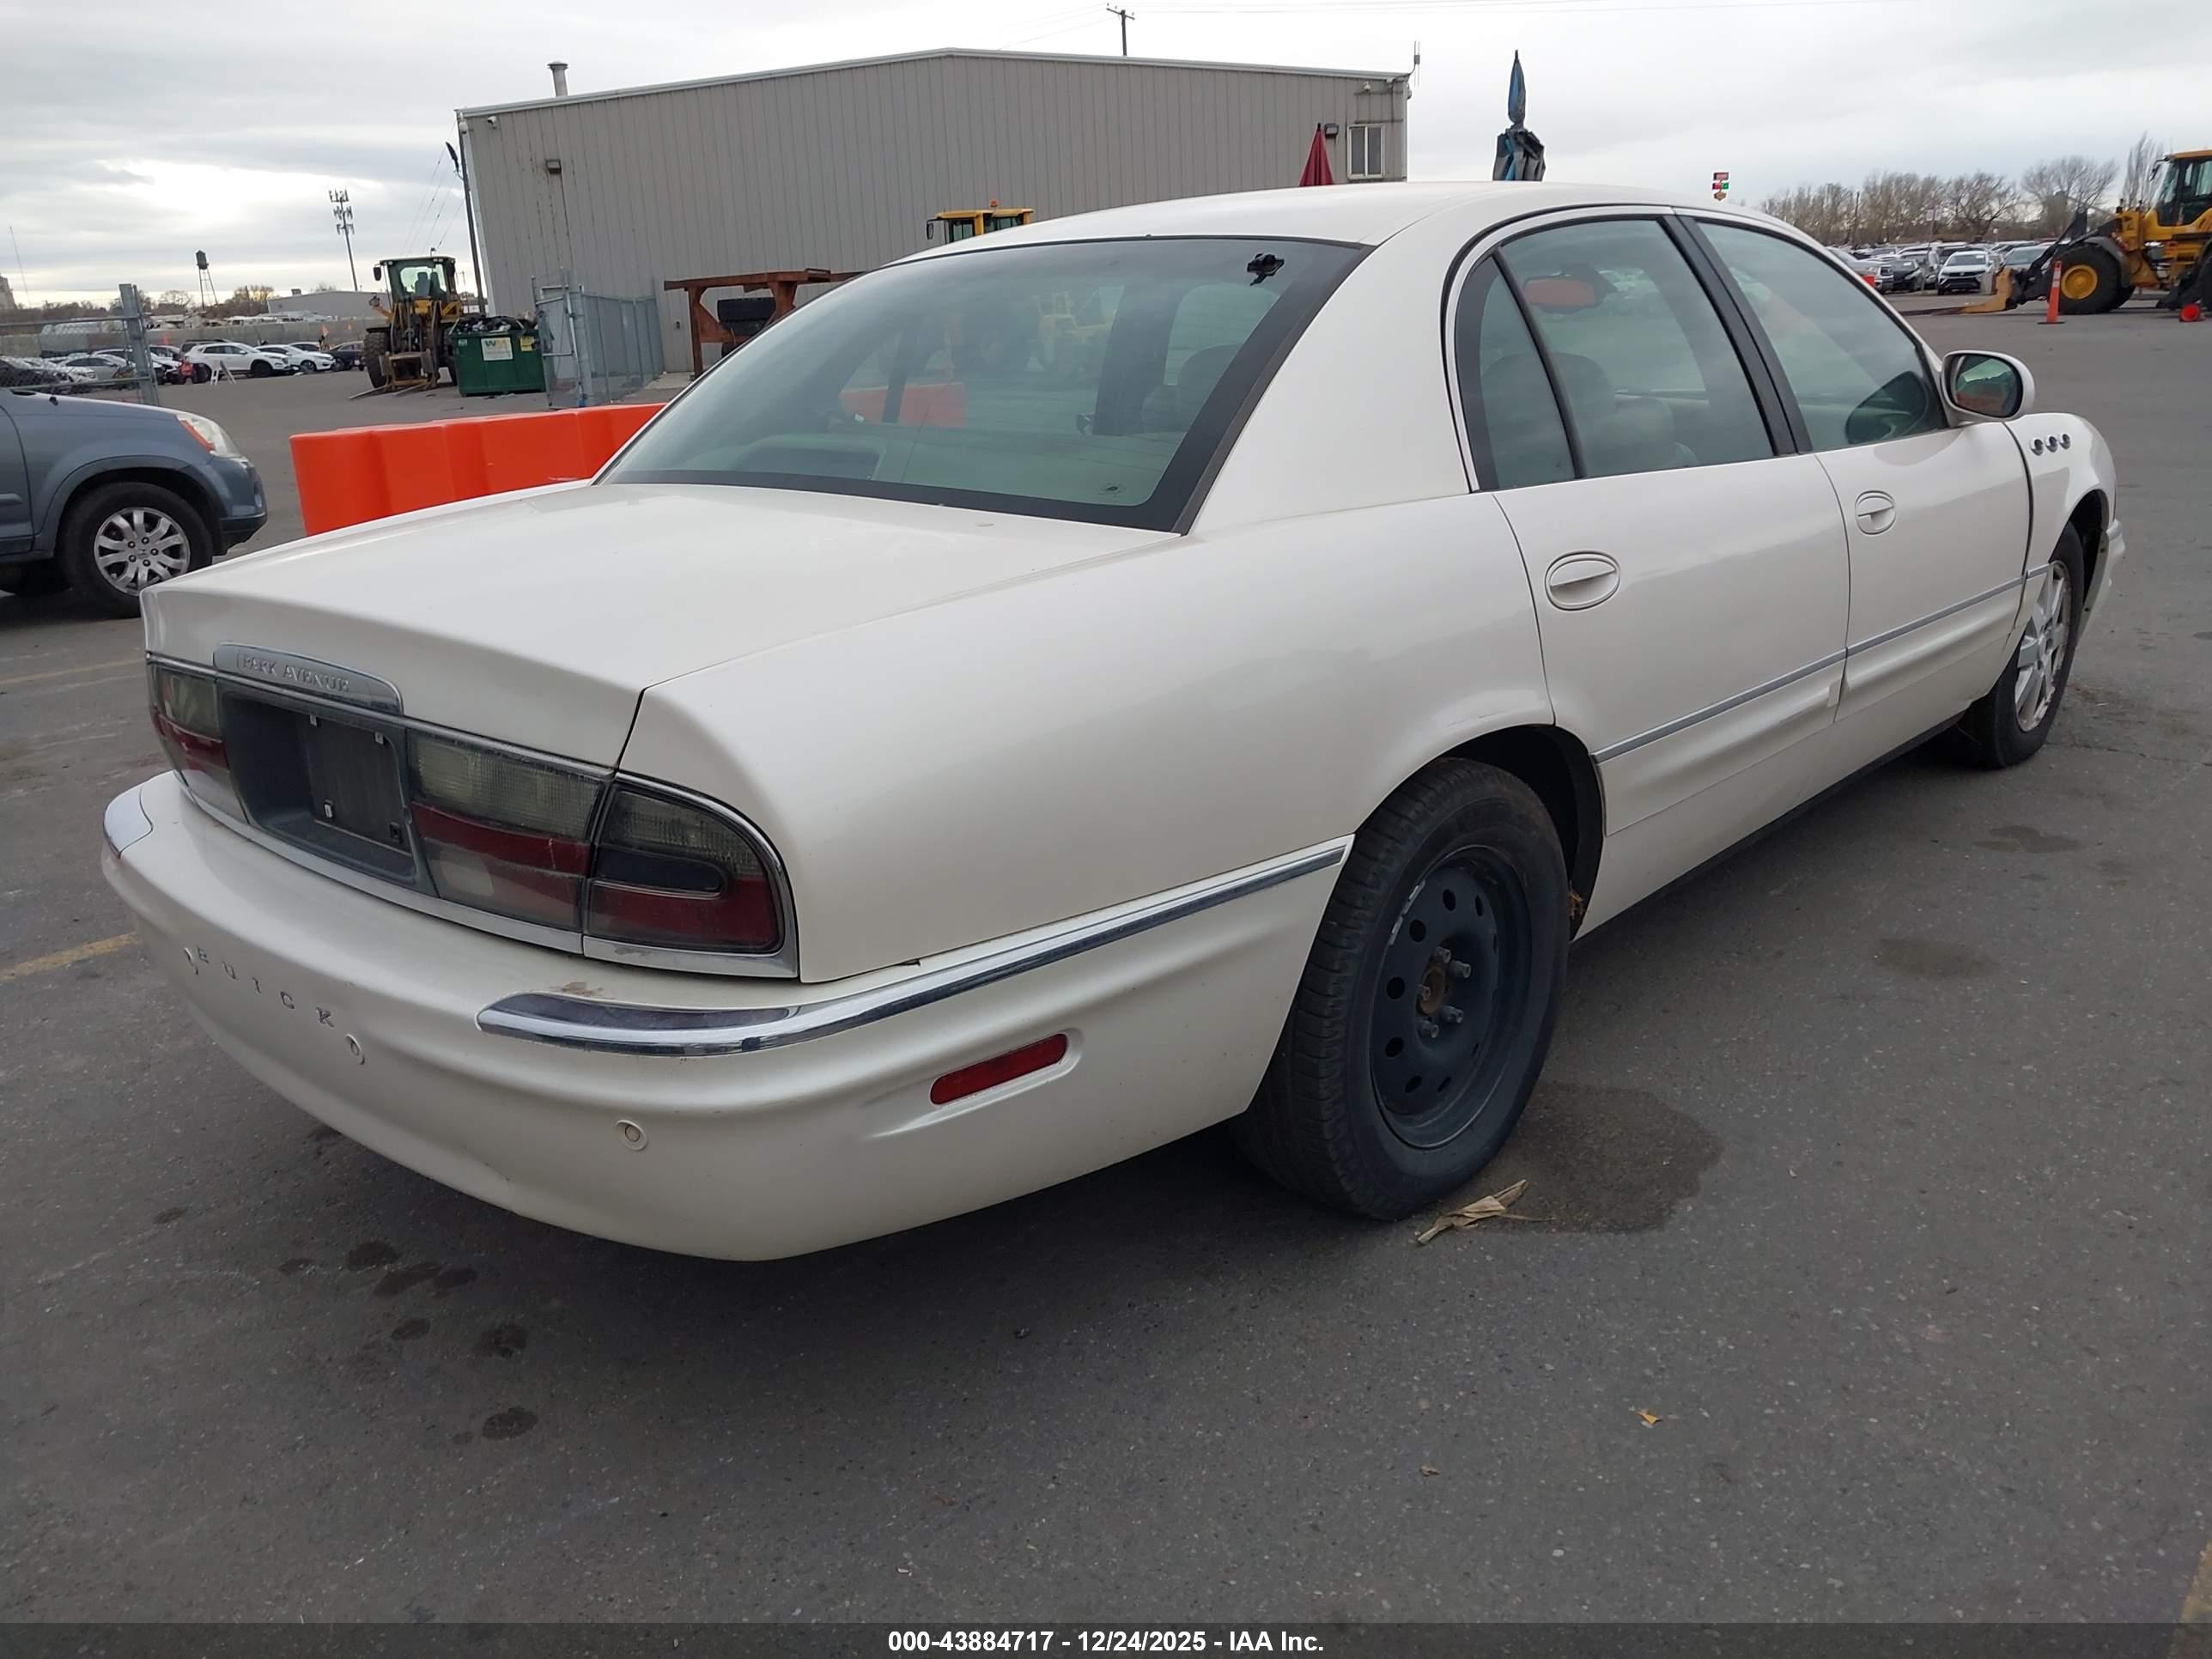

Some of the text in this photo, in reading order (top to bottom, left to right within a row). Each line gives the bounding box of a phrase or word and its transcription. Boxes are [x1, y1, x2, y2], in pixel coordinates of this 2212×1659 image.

[243, 654, 350, 692] PARK AVENUE
[197, 946, 335, 1028] BUICK
